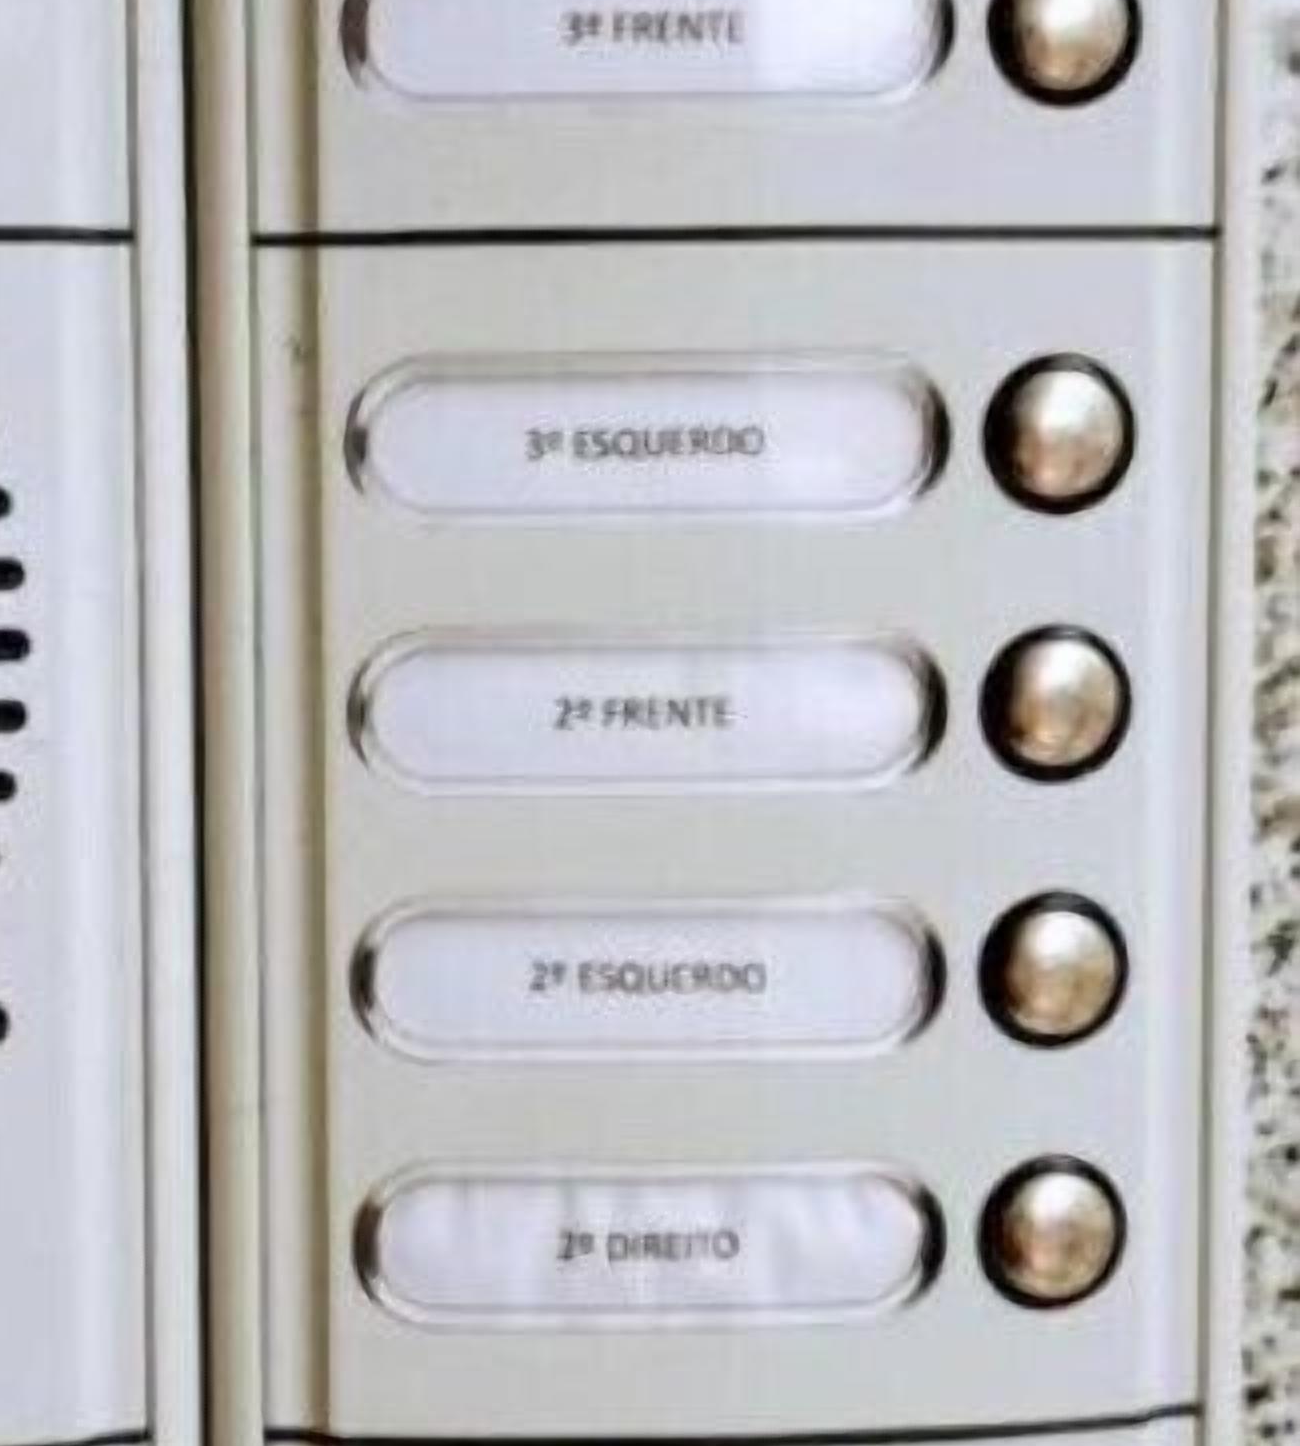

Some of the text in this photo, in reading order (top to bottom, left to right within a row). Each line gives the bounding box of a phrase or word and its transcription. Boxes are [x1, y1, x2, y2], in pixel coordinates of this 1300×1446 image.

[612, 9, 745, 45] FRENTE
[572, 424, 767, 461] ESQUERDO
[602, 694, 734, 731] FRENTE
[577, 961, 769, 995] ESQUERDO
[606, 1228, 742, 1263] DIREITO
